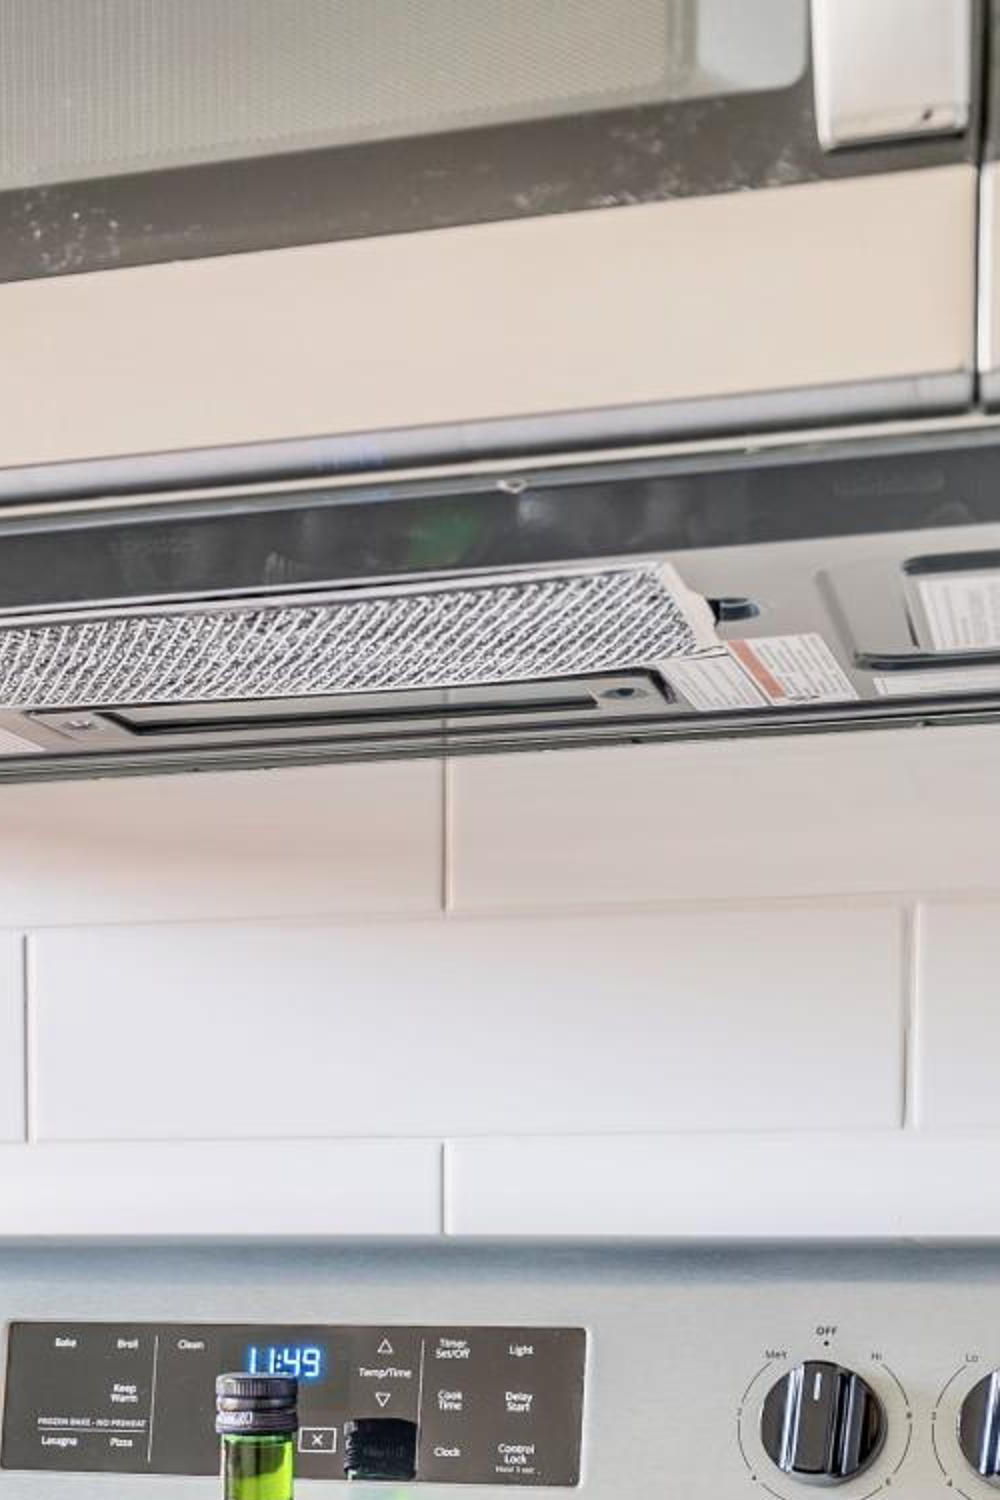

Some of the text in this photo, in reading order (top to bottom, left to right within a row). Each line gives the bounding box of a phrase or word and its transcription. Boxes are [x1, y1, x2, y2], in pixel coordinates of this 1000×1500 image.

[815, 1326, 838, 1337] OFF
[55, 1337, 77, 1348] Bake
[117, 1338, 139, 1349] Broil
[177, 1339, 205, 1350] Clean
[439, 1337, 468, 1349] Timer
[436, 1348, 471, 1359] Set/Off
[508, 1344, 534, 1357] Light
[249, 1346, 321, 1377] 11:49
[870, 1352, 882, 1361] Hi
[965, 1353, 979, 1363] Lo
[359, 1367, 413, 1379] Temp/Time
[113, 1383, 137, 1395] Keep
[437, 1389, 463, 1400] Cook
[110, 1394, 139, 1403] Warm
[505, 1391, 533, 1403] Delay
[438, 1400, 463, 1411] Time
[506, 1401, 531, 1412] Start
[41, 1435, 78, 1447] Lasagna
[109, 1437, 133, 1447] Pizza
[433, 1446, 461, 1458] Clock
[497, 1443, 535, 1455] Control
[504, 1454, 527, 1465] Lock
